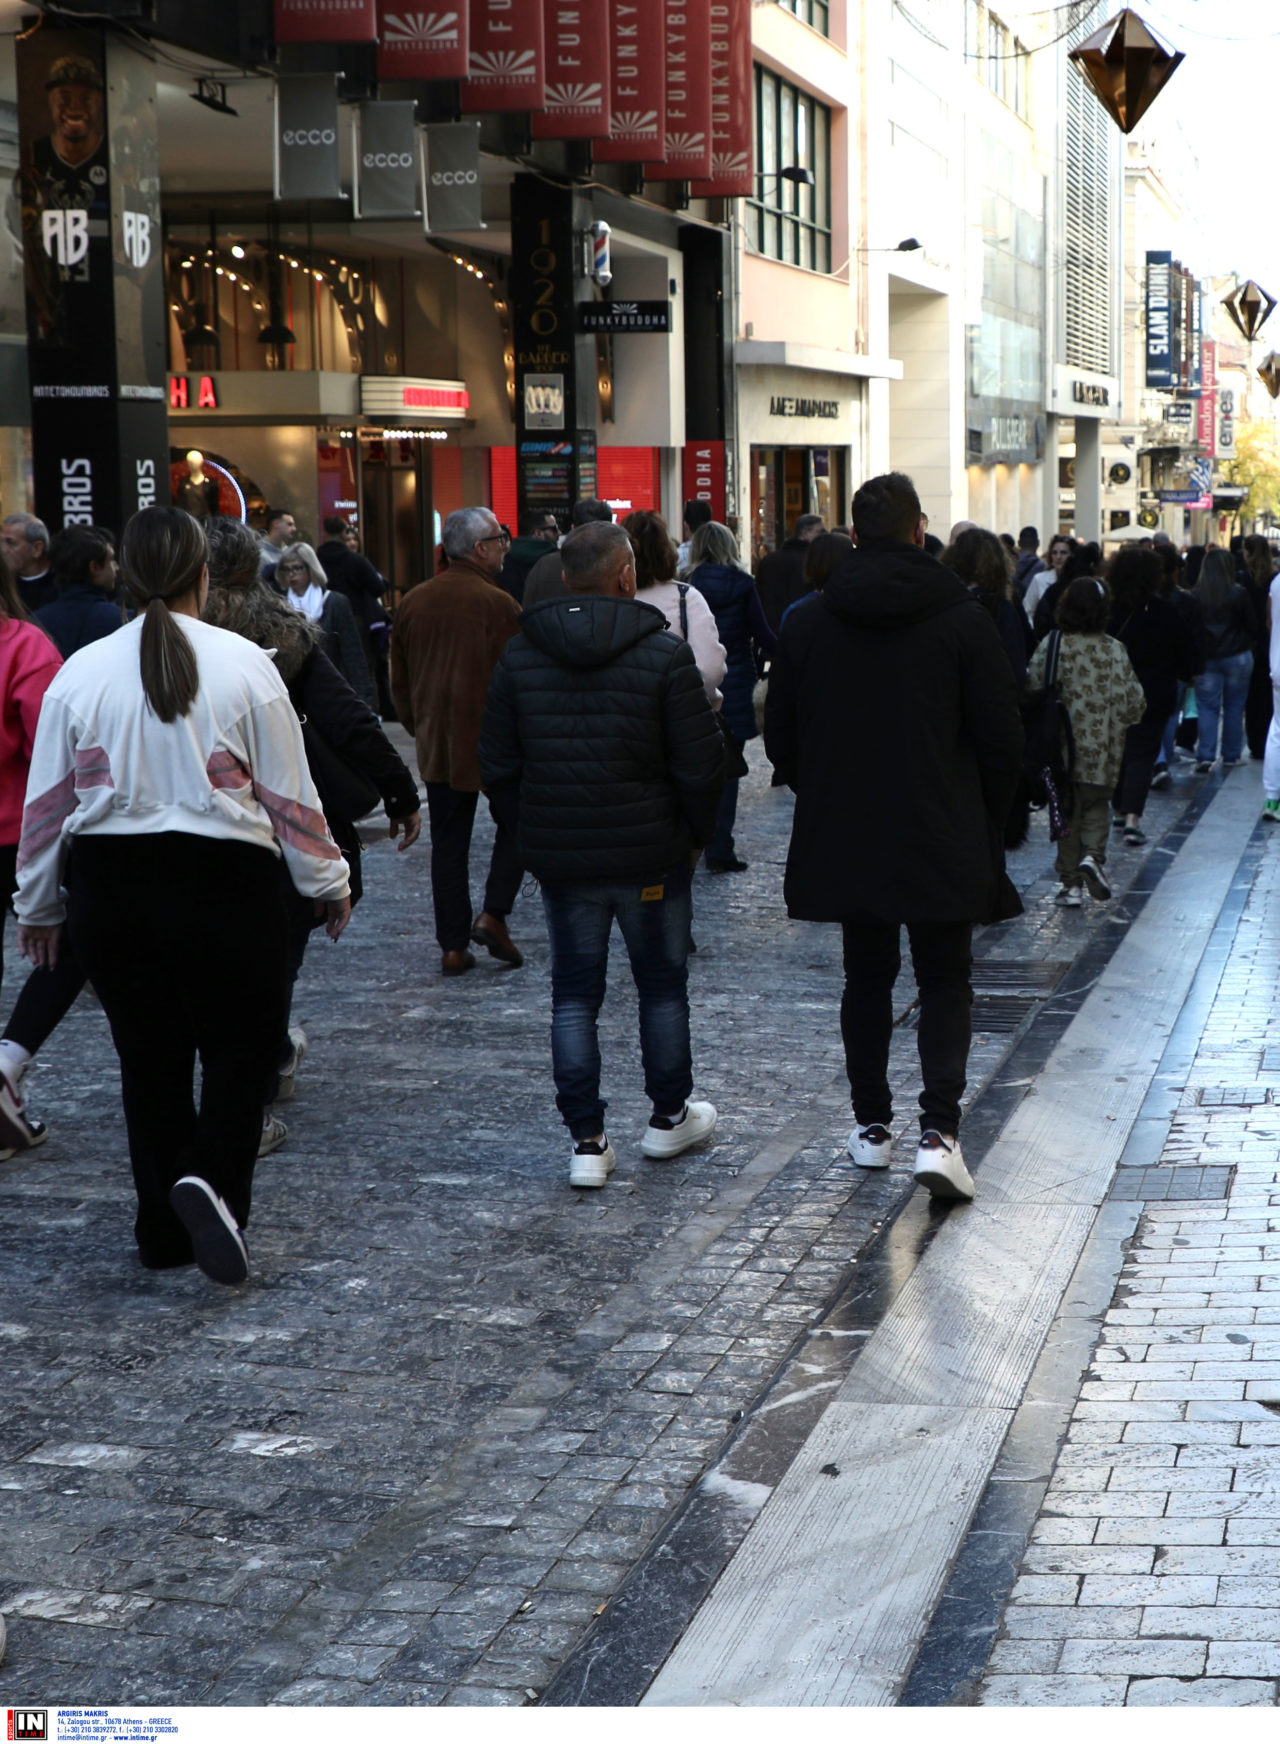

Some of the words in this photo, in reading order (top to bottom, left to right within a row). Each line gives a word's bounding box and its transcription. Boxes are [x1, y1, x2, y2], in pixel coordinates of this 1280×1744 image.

[558, 0, 580, 66] FUN
[283, 129, 336, 145] ecco
[363, 153, 413, 167] ecco
[432, 170, 478, 185] ecco
[1149, 263, 1169, 308] DUNK
[584, 315, 666, 325] FUNKYBUDDHA
[1149, 311, 1169, 355] SLAM
[169, 376, 217, 408] HA
